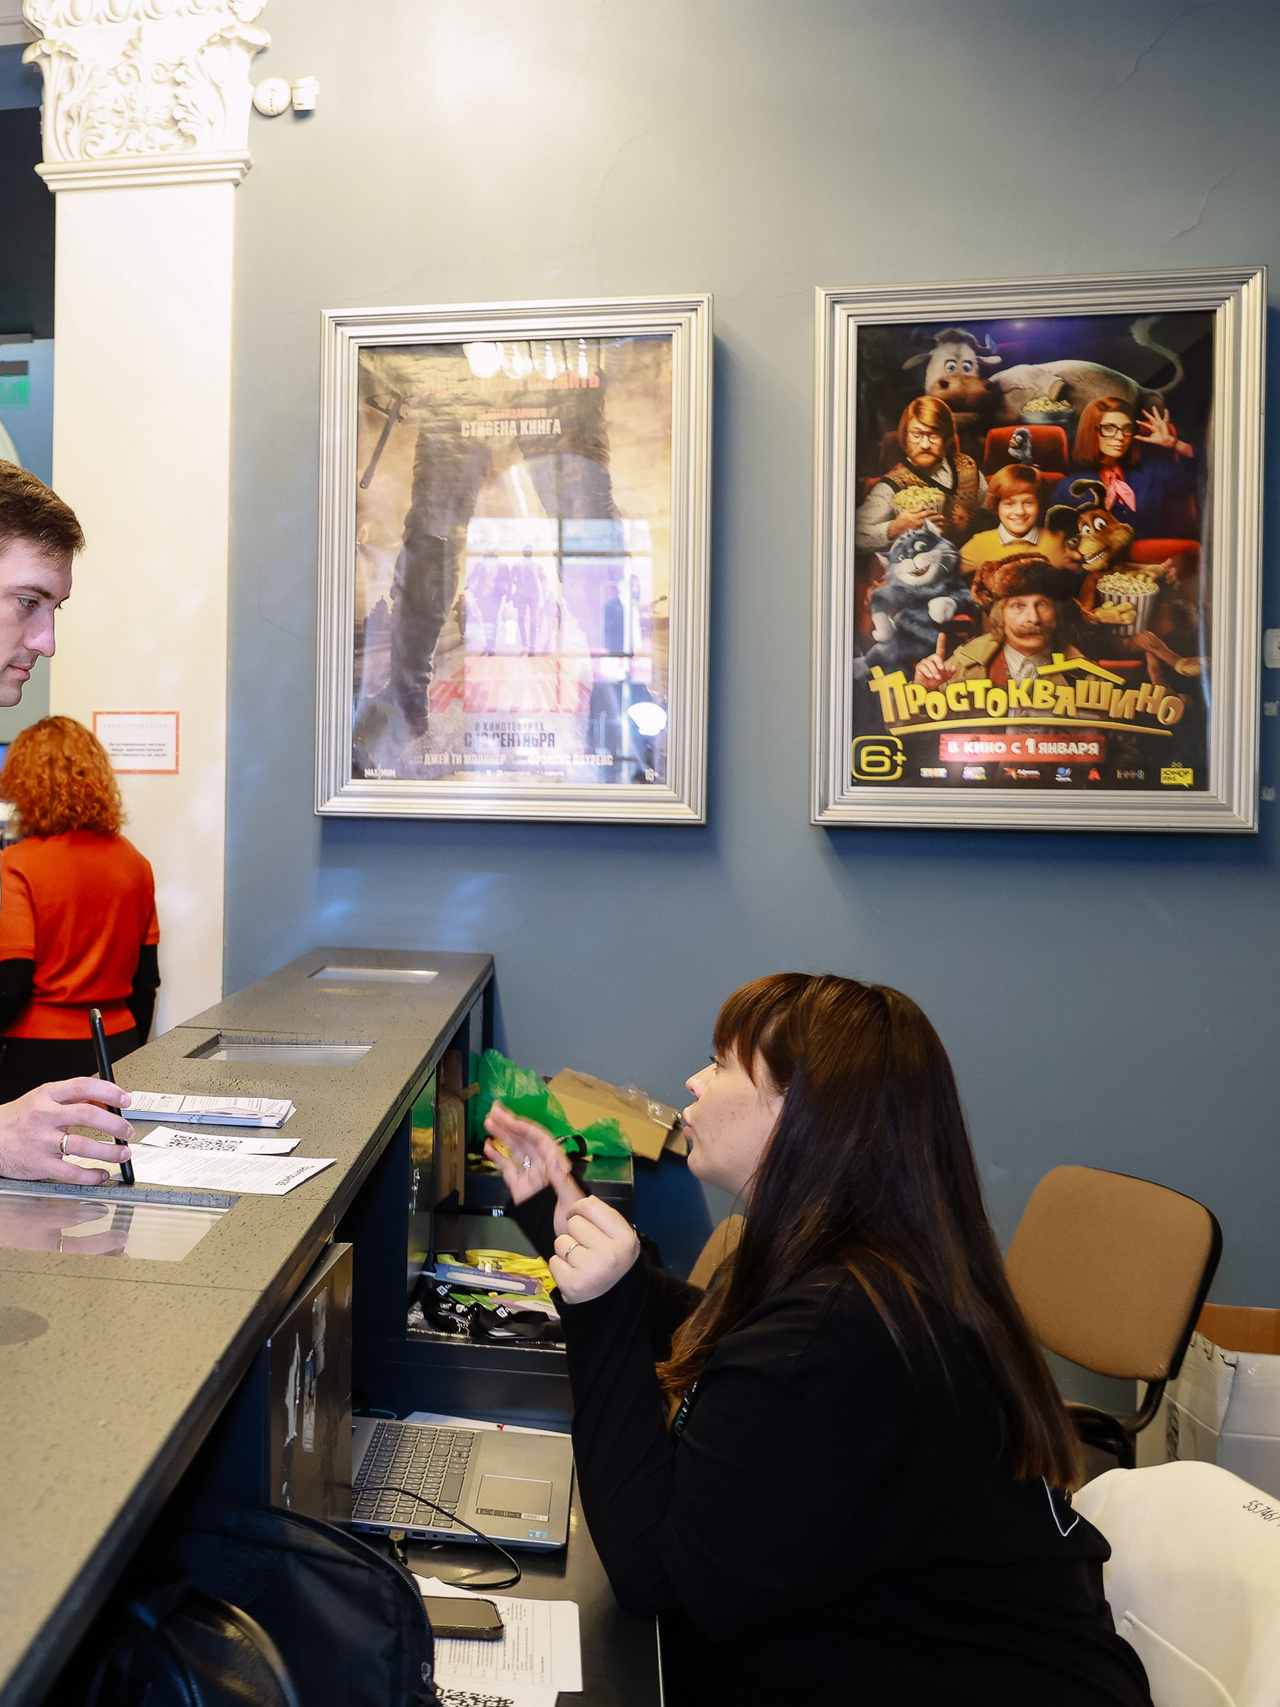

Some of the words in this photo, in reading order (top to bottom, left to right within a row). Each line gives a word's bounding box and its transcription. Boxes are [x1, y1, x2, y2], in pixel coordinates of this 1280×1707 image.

[461, 419, 518, 438] СТИВЕНА
[520, 418, 562, 436] КИНГА
[868, 662, 1186, 726] ПРОСТОКВАШИНО
[464, 732, 472, 748] С
[947, 741, 959, 754] В
[964, 741, 1006, 755] КИНО
[1011, 742, 1021, 755] С
[1025, 737, 1036, 756] 1
[1038, 741, 1100, 756] ЯНВАРЯ
[857, 742, 907, 776] 6+
